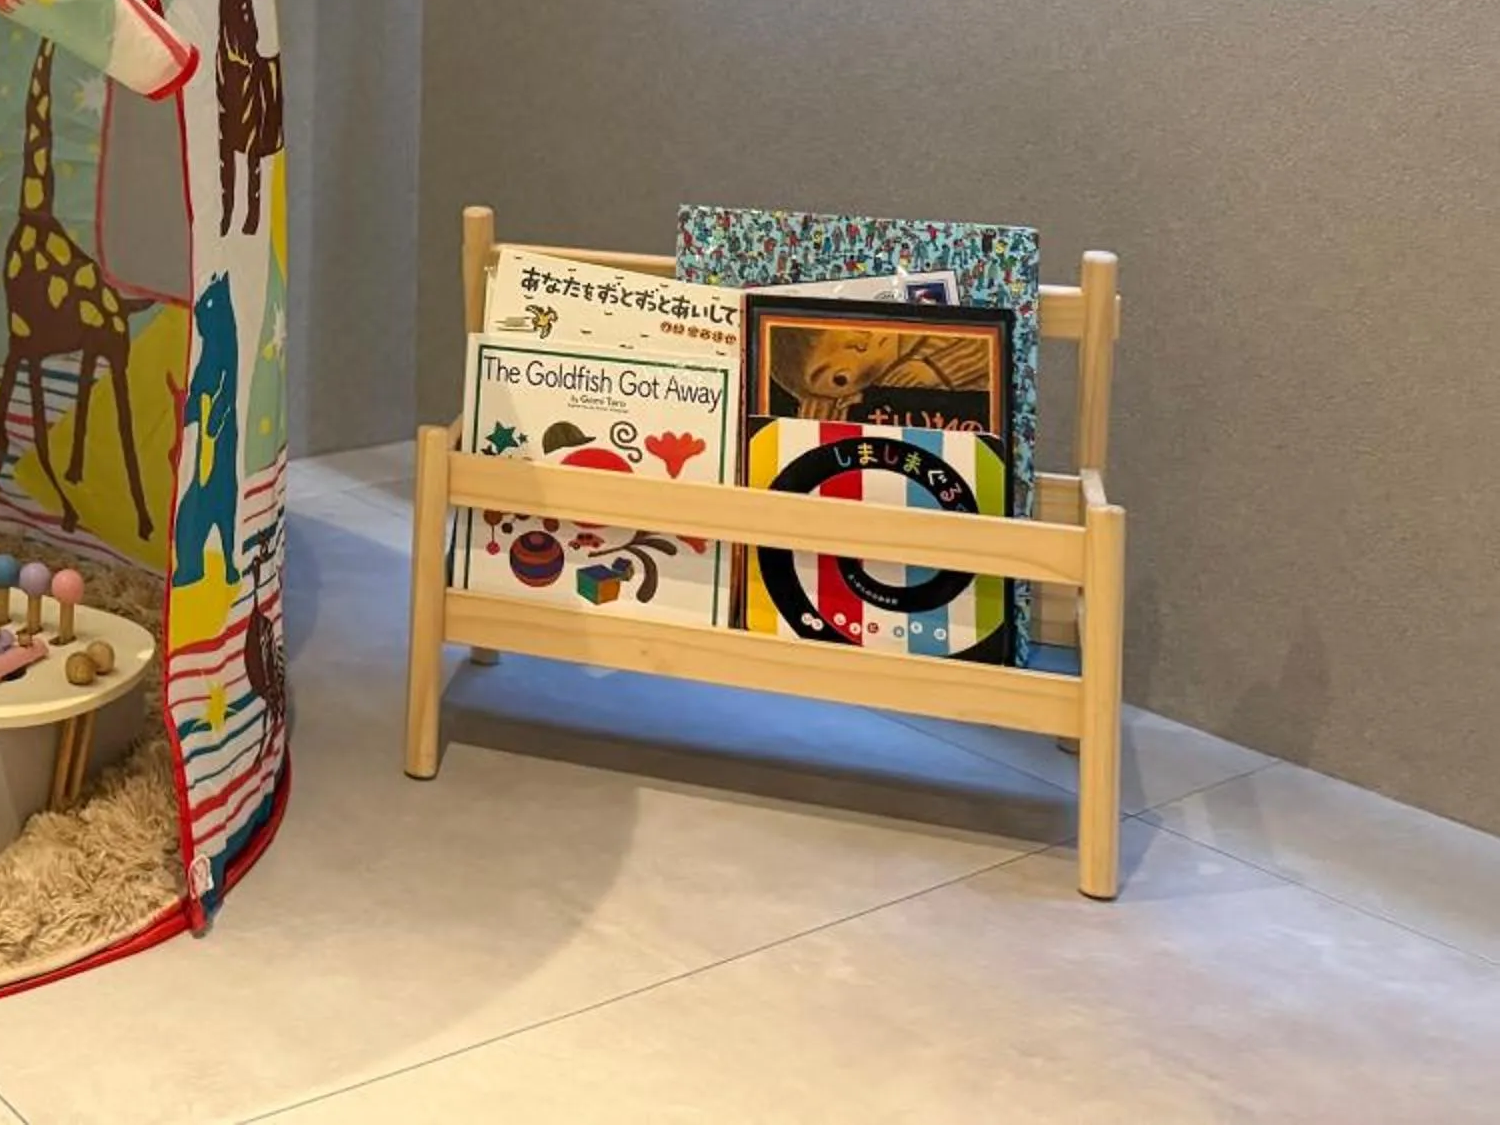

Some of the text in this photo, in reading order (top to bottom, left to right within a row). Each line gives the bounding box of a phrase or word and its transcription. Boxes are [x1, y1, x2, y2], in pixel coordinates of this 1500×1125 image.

[521, 267, 740, 325] あなたをずっとずっとあいして
[483, 355, 723, 414] The Goldfish Got Away
[833, 442, 967, 510] しましまぐる
